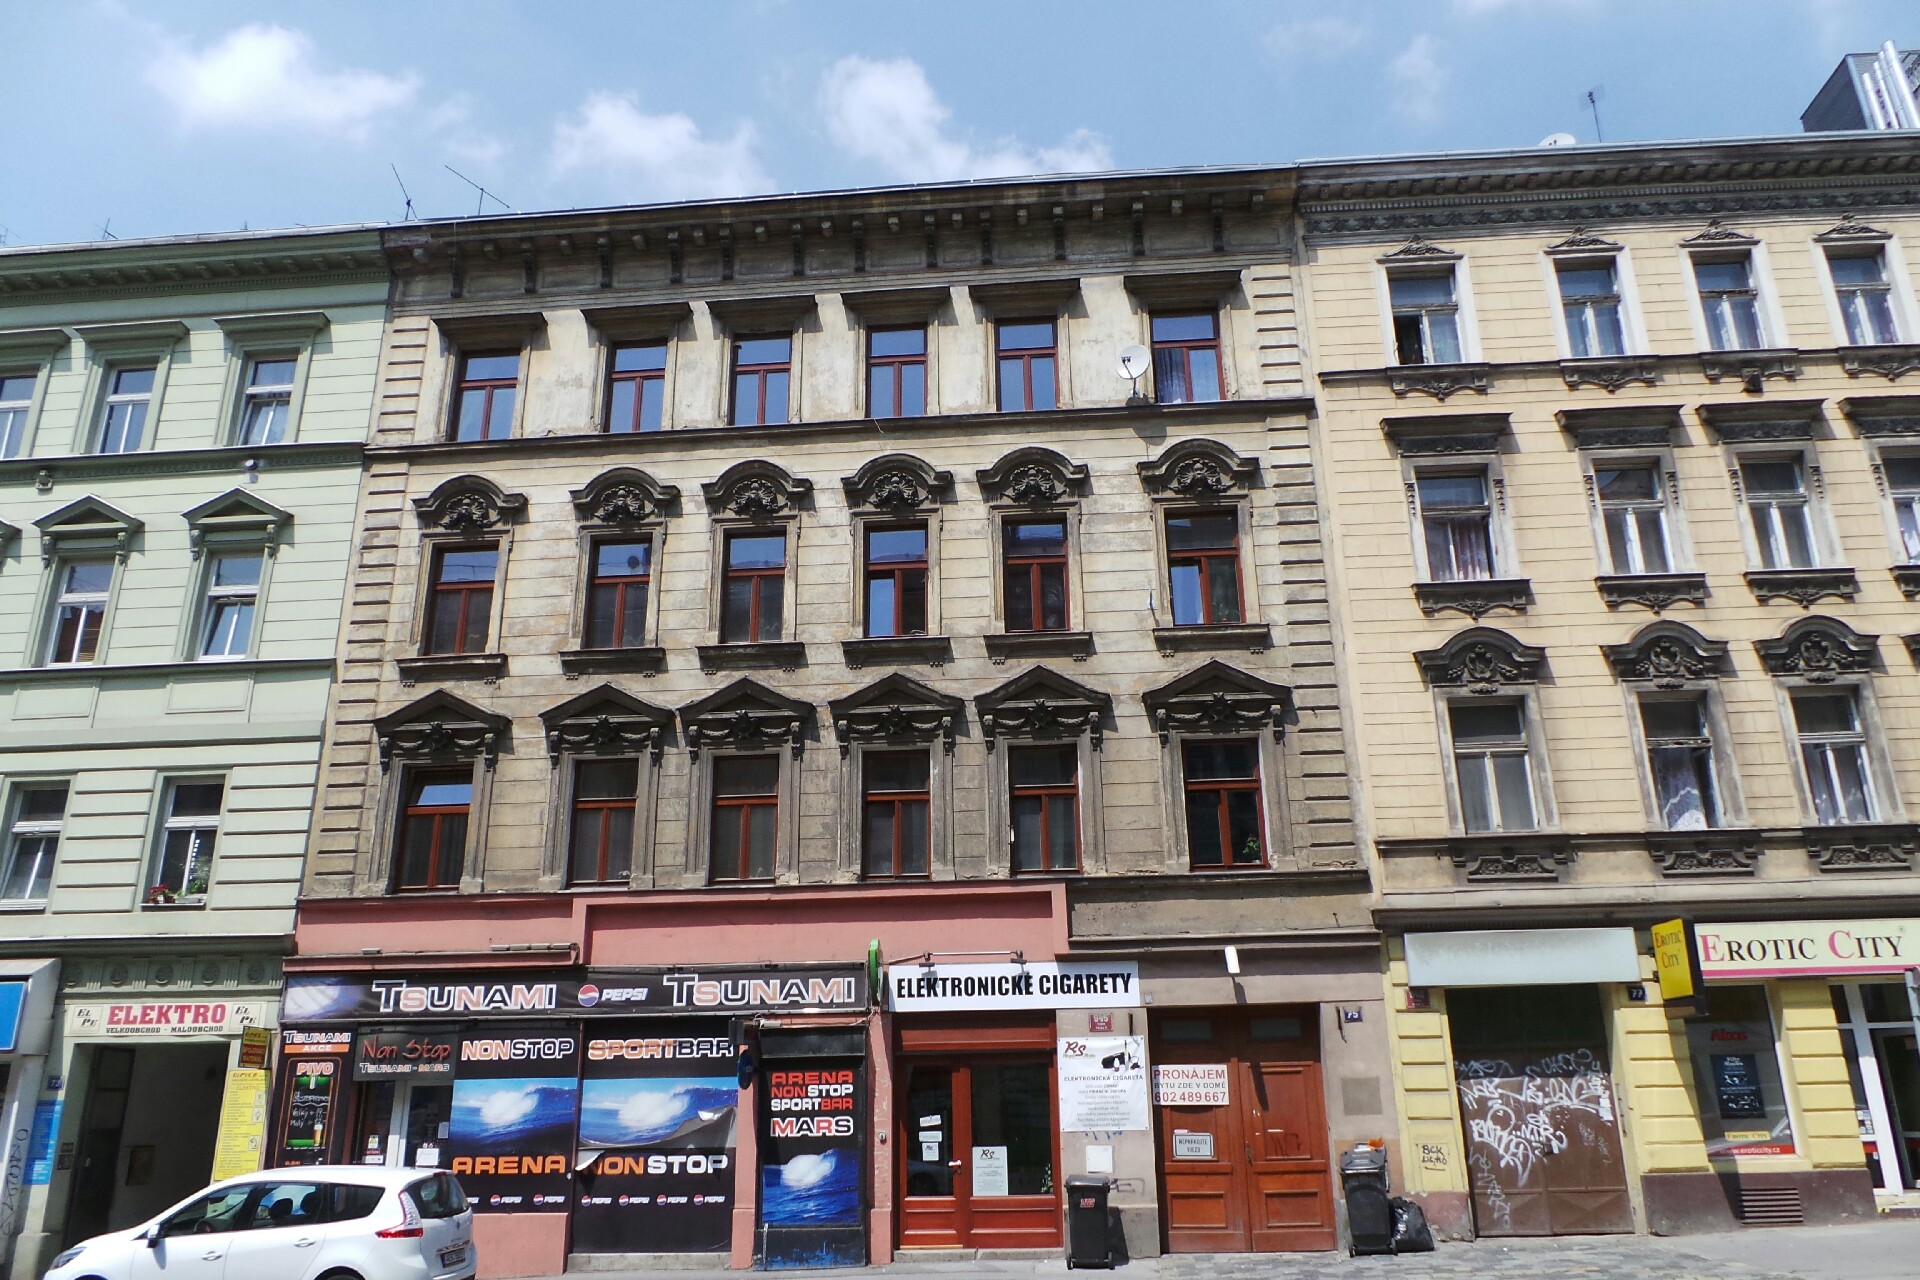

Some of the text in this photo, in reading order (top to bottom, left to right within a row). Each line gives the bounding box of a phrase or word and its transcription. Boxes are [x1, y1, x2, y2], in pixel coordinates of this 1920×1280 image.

[1698, 930, 1903, 962] EROTIC CITY
[663, 974, 855, 1007] TSUNAMI
[897, 972, 1132, 998] ELEKTRONICKÉ CIGARETY
[372, 980, 557, 1013] TSUNAMI
[601, 987, 648, 1001] PEPSI
[107, 1003, 226, 1026] ELEKTRO
[106, 1026, 160, 1034] VELKOOBCHOD
[170, 1025, 223, 1033] MALOOBCHOD
[283, 1030, 351, 1044] TSUNAMI
[303, 1044, 333, 1052] AKCE
[363, 1035, 452, 1062] Non Stop
[296, 1062, 334, 1076] PIVO
[359, 1062, 412, 1073] TSUNAMI
[418, 1063, 450, 1073] MARS
[1154, 1067, 1226, 1080] PRONÁJEM
[771, 1070, 853, 1085] ARENA
[1154, 1091, 1226, 1103] 602 489 667
[770, 1116, 854, 1138] MARS
[452, 1154, 566, 1175] ARENA
